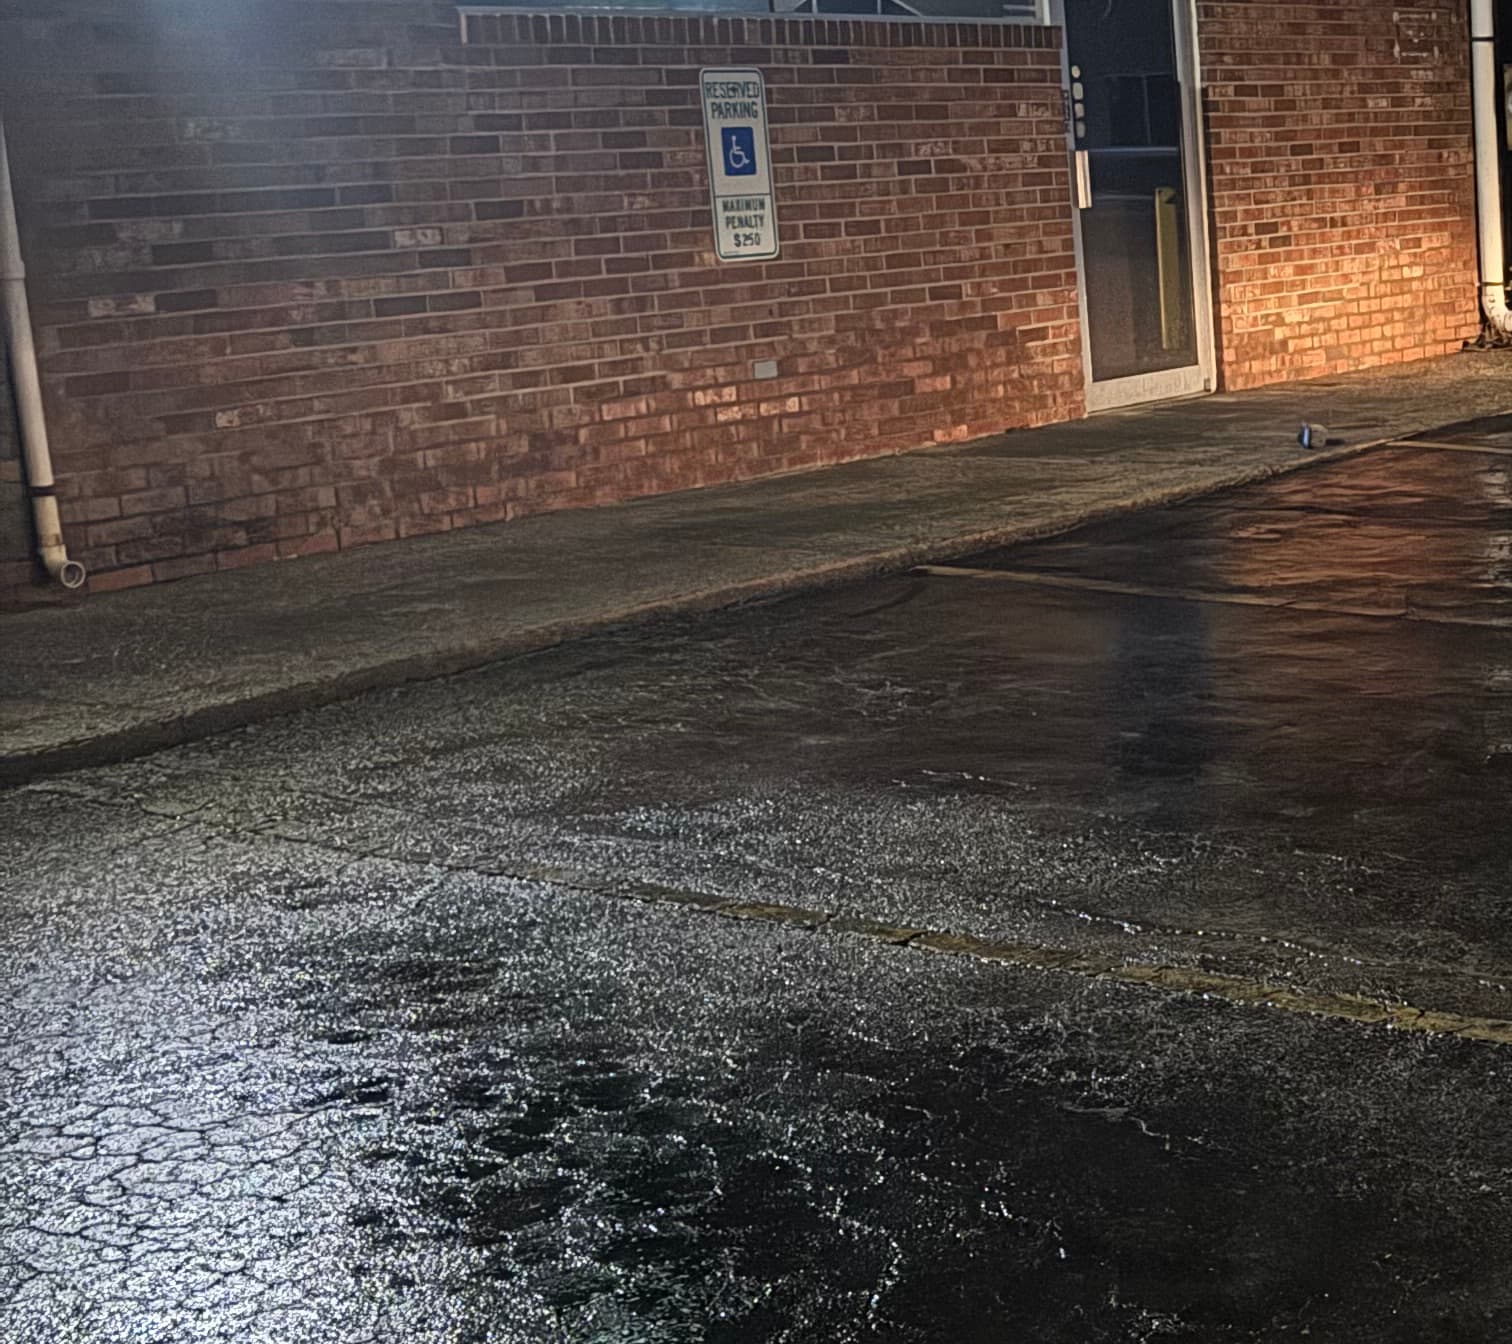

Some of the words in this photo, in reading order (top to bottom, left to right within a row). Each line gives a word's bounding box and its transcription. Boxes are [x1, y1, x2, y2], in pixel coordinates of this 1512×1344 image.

[705, 81, 760, 99] RESERVED
[711, 102, 758, 120] PARKING
[722, 198, 765, 213] MAXIMUM
[725, 215, 764, 230] PENALTY
[734, 233, 761, 247] $250
